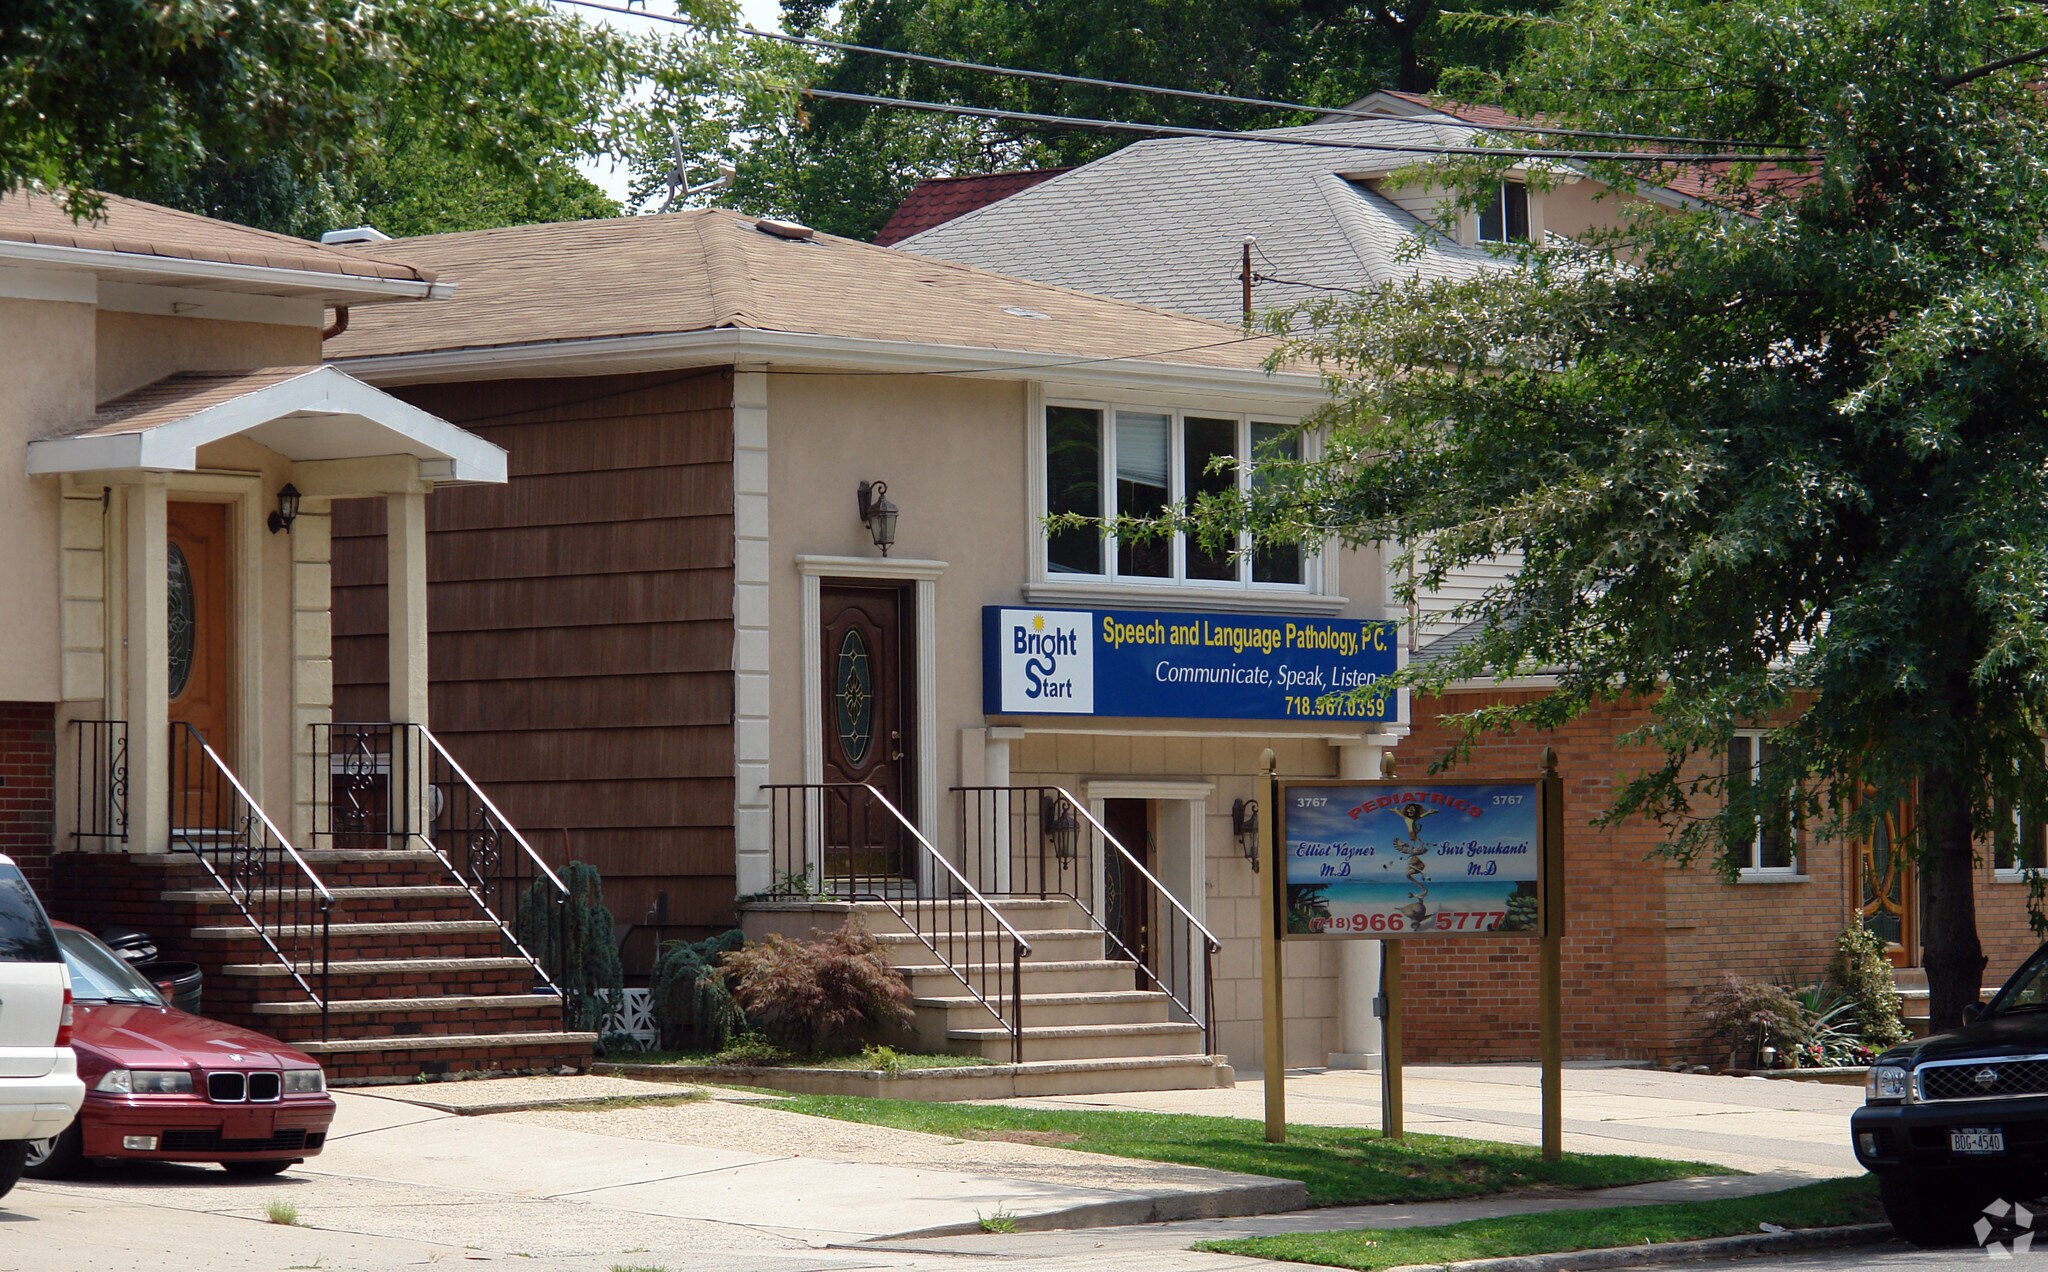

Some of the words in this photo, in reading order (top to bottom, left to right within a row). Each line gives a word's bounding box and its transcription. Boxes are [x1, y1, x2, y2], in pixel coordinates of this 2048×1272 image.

[1103, 616, 1165, 650] Speech
[1170, 620, 1200, 646] and
[1204, 620, 1281, 655] Language
[1285, 623, 1358, 656] Pathology,
[1013, 625, 1077, 676] Bright
[1025, 657, 1072, 699] Start
[1155, 660, 1273, 688] Communicate,
[1277, 664, 1327, 691] Speak,
[1331, 665, 1376, 687] Listen
[1285, 696, 1385, 717] 718.967.0359
[1297, 797, 1328, 808] 3767
[1347, 791, 1484, 821] PEDIATRICS
[1492, 795, 1523, 806] 3767
[1296, 842, 1331, 857] Elliot
[1333, 842, 1375, 861] Vayner
[1437, 841, 1465, 856] Suri
[1466, 840, 1528, 857] Gorukanti
[1320, 861, 1351, 877] M.D
[1467, 860, 1497, 876] M.D
[1436, 911, 1505, 930] 5777
